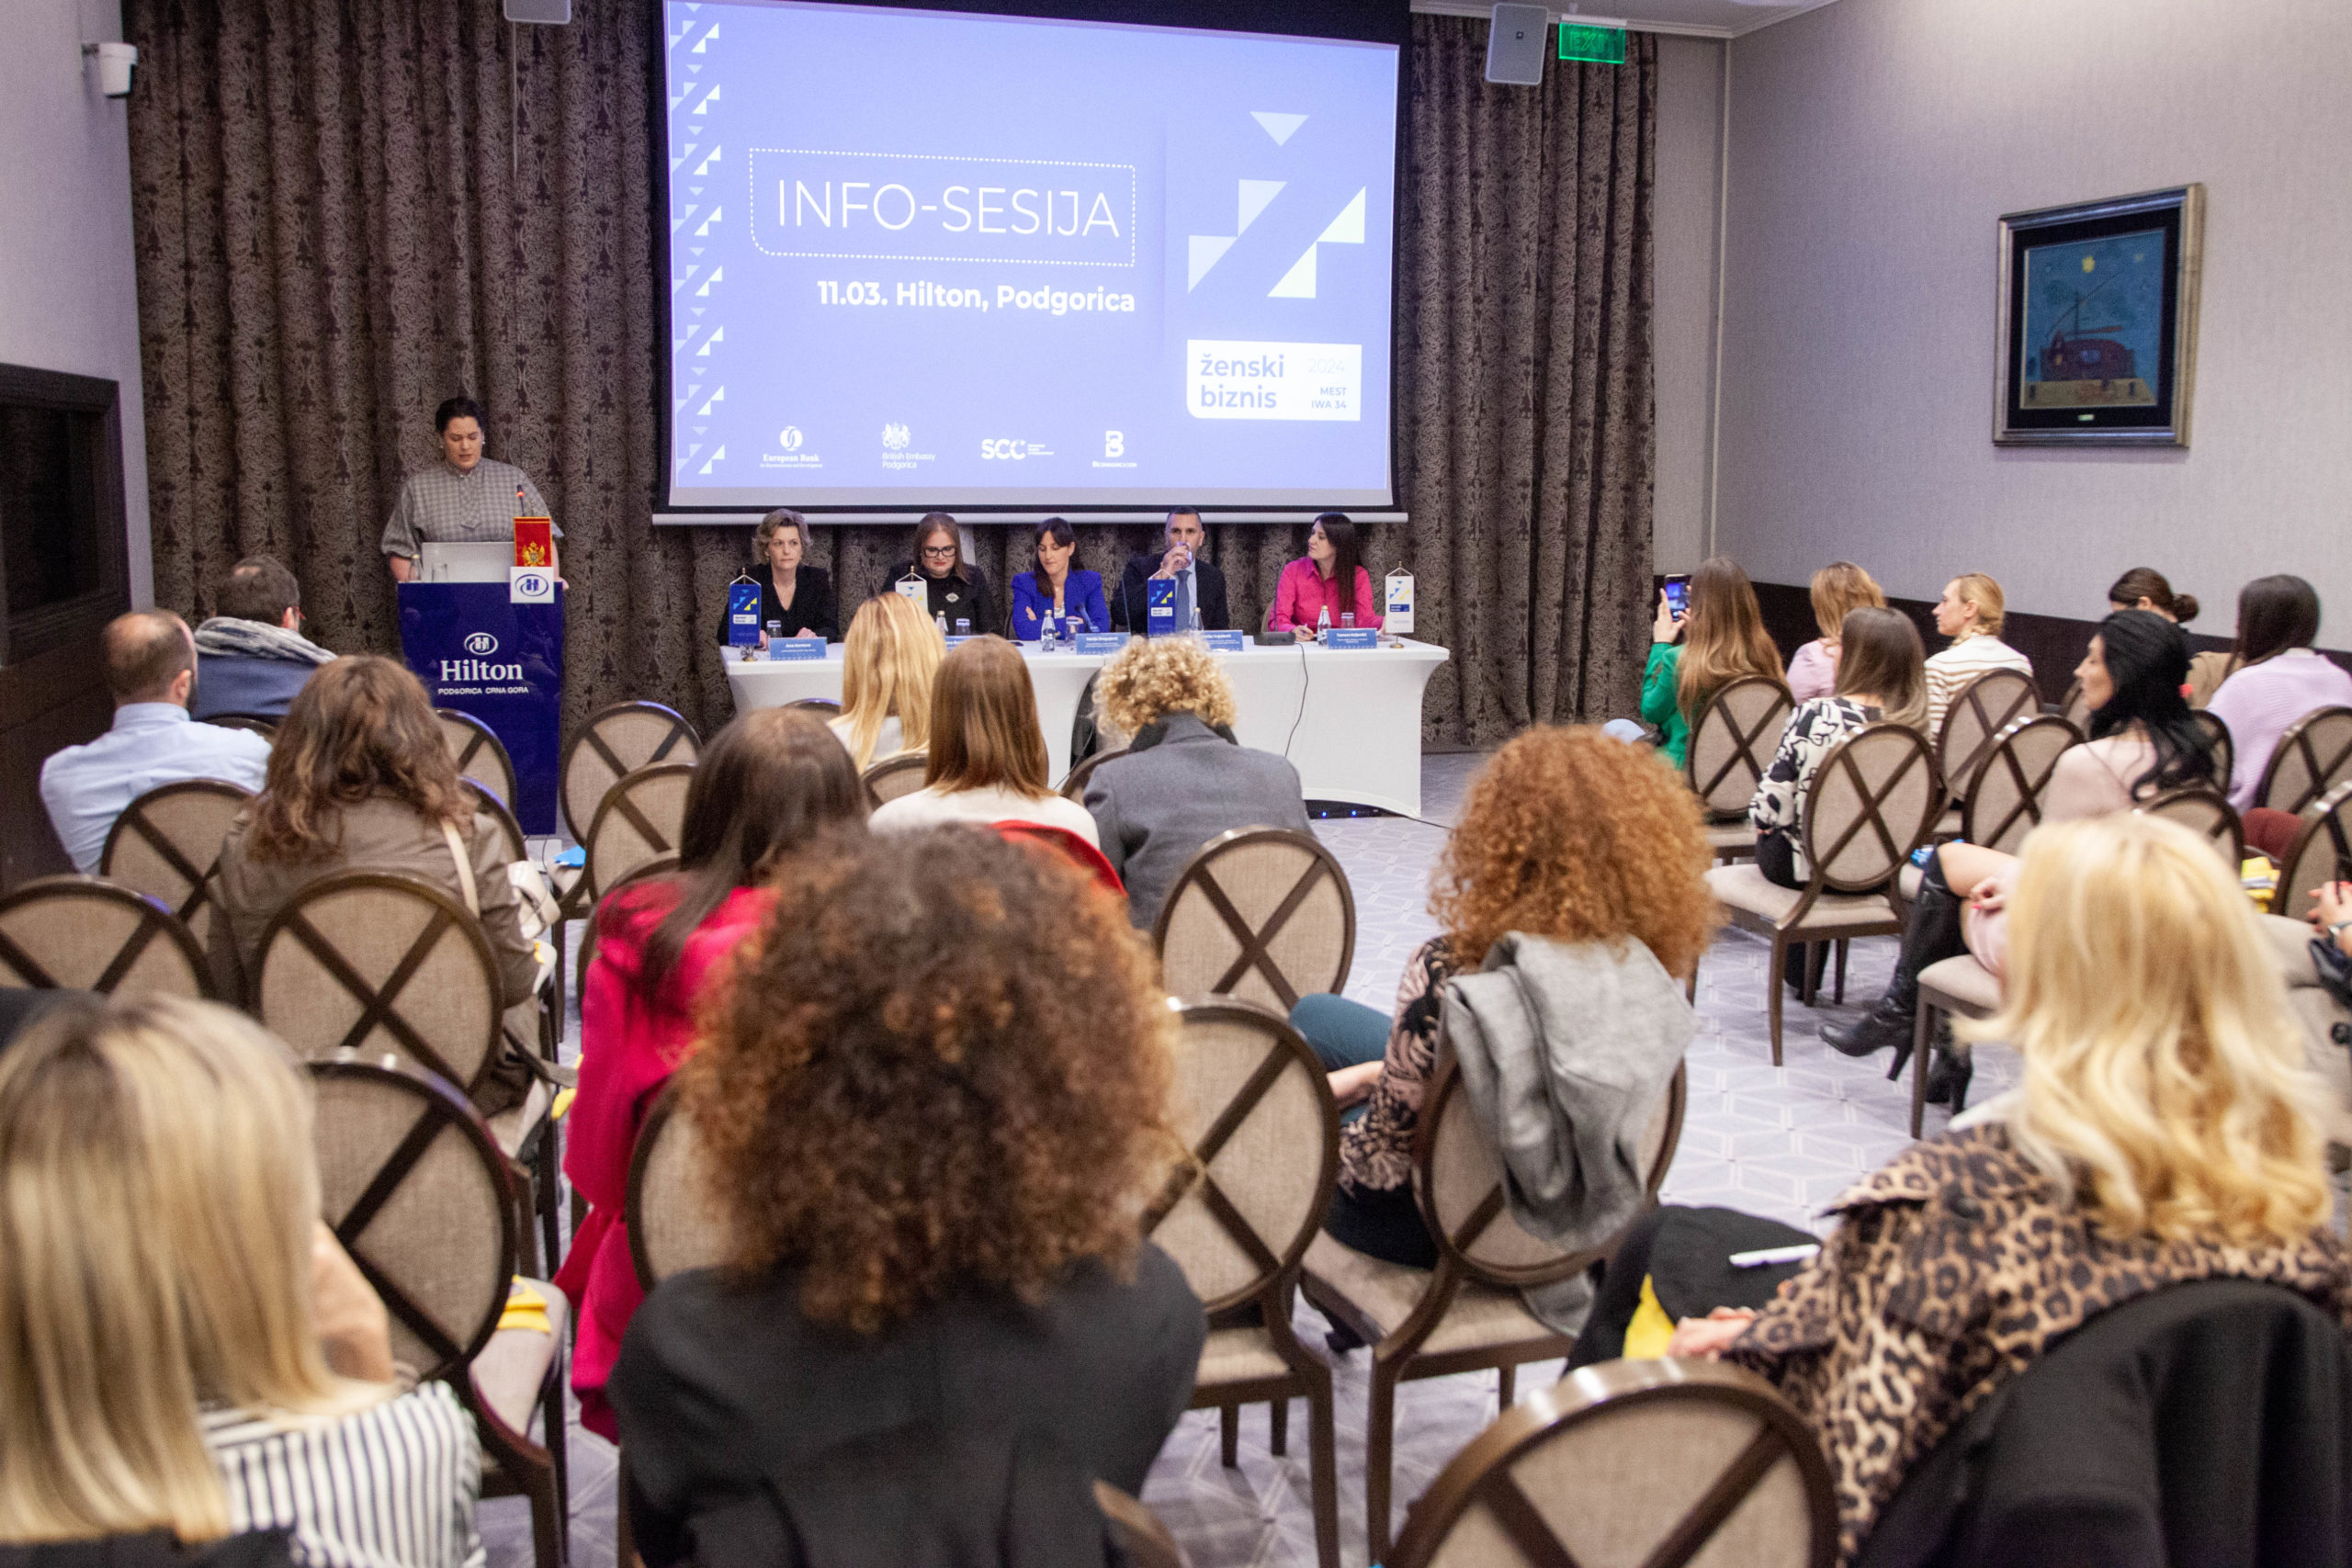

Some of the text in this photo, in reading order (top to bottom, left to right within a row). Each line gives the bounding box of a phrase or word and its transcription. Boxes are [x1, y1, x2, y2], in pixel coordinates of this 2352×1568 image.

[779, 179, 1120, 238] INFO-SESIJA
[817, 280, 1136, 316] 11.03. Hilton, Podgorica
[1200, 353, 1285, 378] ženski
[1200, 383, 1277, 409] biznis
[1319, 387, 1348, 397] MEST
[1311, 400, 1348, 410] IWA 34
[763, 453, 820, 464] European Bank
[980, 438, 1026, 460] SCC
[440, 659, 524, 682] Hilton
[437, 686, 529, 695] PODGORICA CRNA GORA
